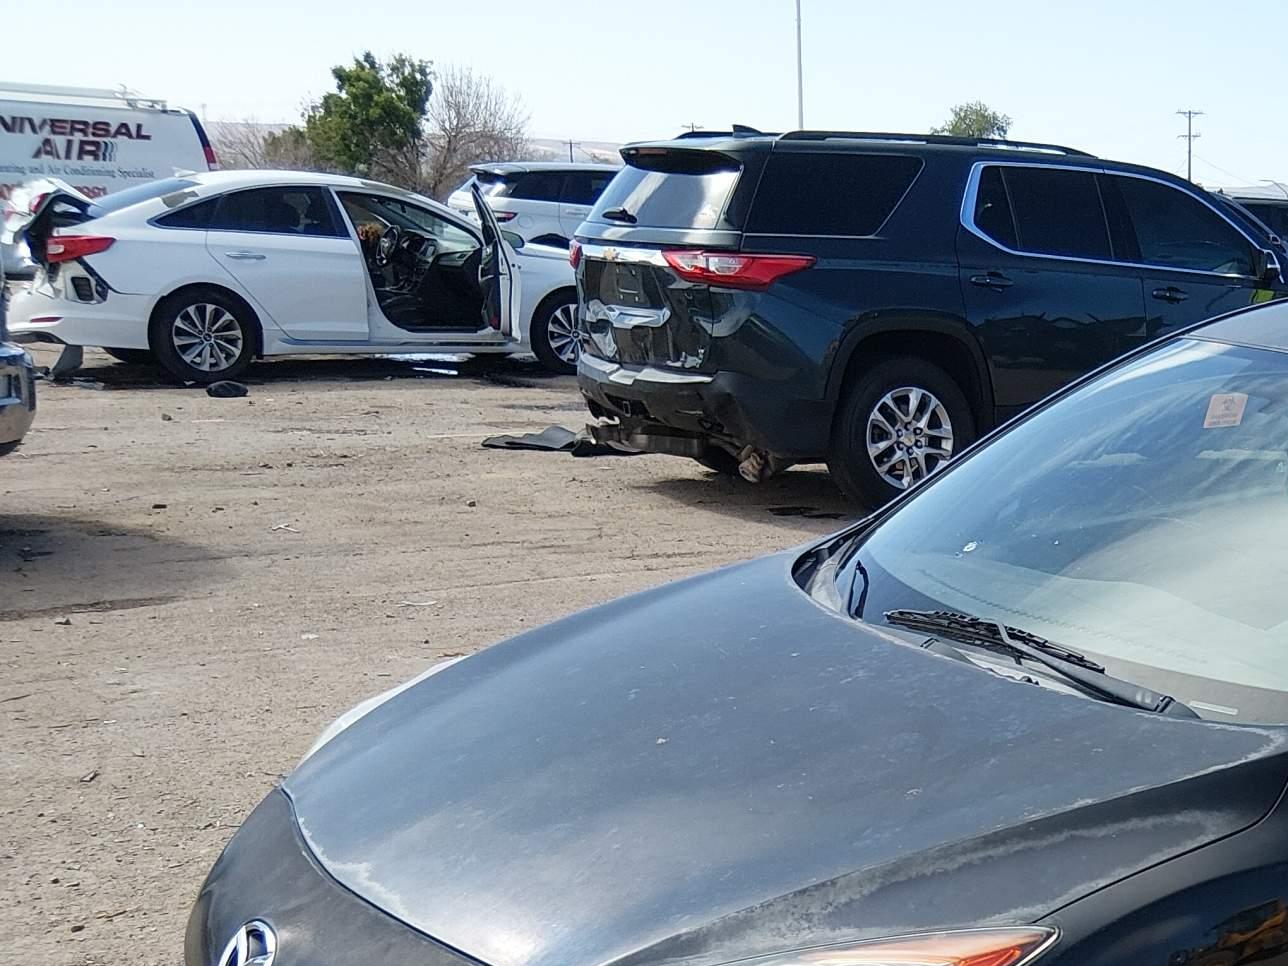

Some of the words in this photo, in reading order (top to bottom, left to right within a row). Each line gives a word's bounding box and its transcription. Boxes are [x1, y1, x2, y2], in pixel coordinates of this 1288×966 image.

[32, 138, 101, 161] AIR
[63, 166, 116, 178] Conditioning
[118, 167, 155, 179] Specialist
